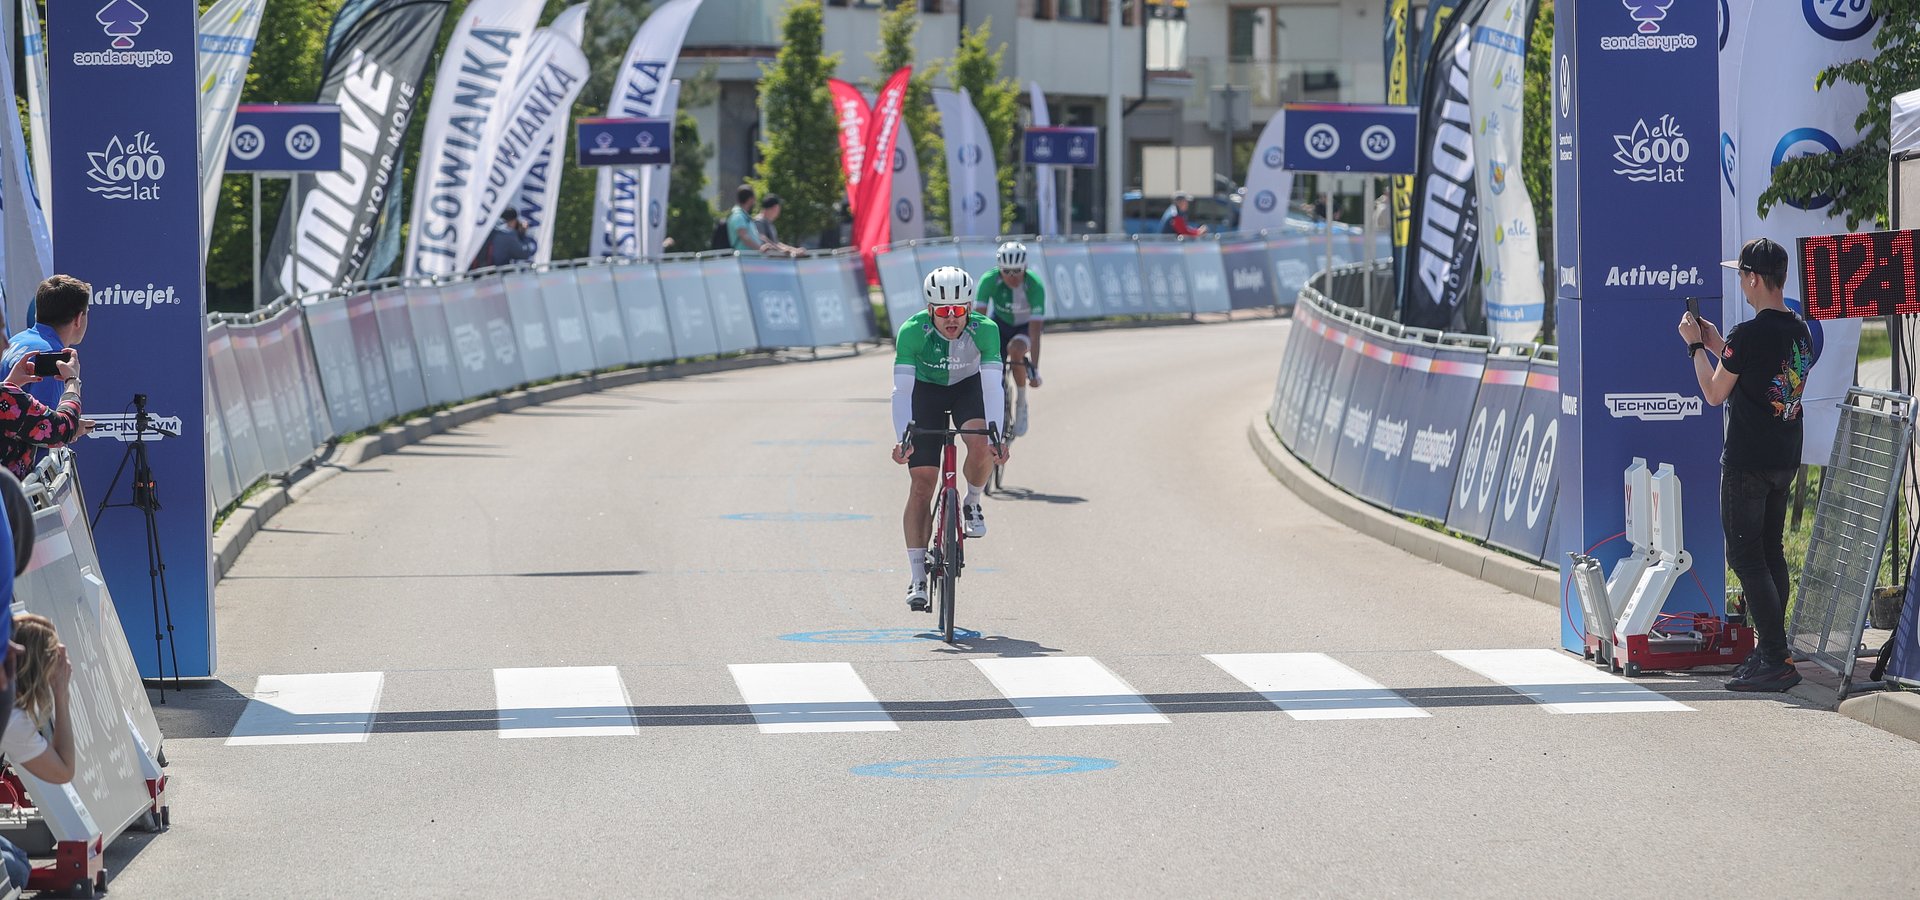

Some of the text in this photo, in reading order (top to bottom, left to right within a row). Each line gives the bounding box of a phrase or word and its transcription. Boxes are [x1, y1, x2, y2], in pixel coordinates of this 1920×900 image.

[1600, 33, 1697, 51] zondacrypto
[74, 49, 173, 67] zondacrypto
[366, 153, 395, 216] YOUR
[387, 81, 416, 147] MOVE
[1632, 138, 1690, 163] 600
[106, 155, 165, 181] 600
[1658, 164, 1684, 182] lat
[133, 182, 160, 200] lat
[1605, 264, 1698, 290] Activejet
[1608, 397, 1698, 413] TECHNOGYM
